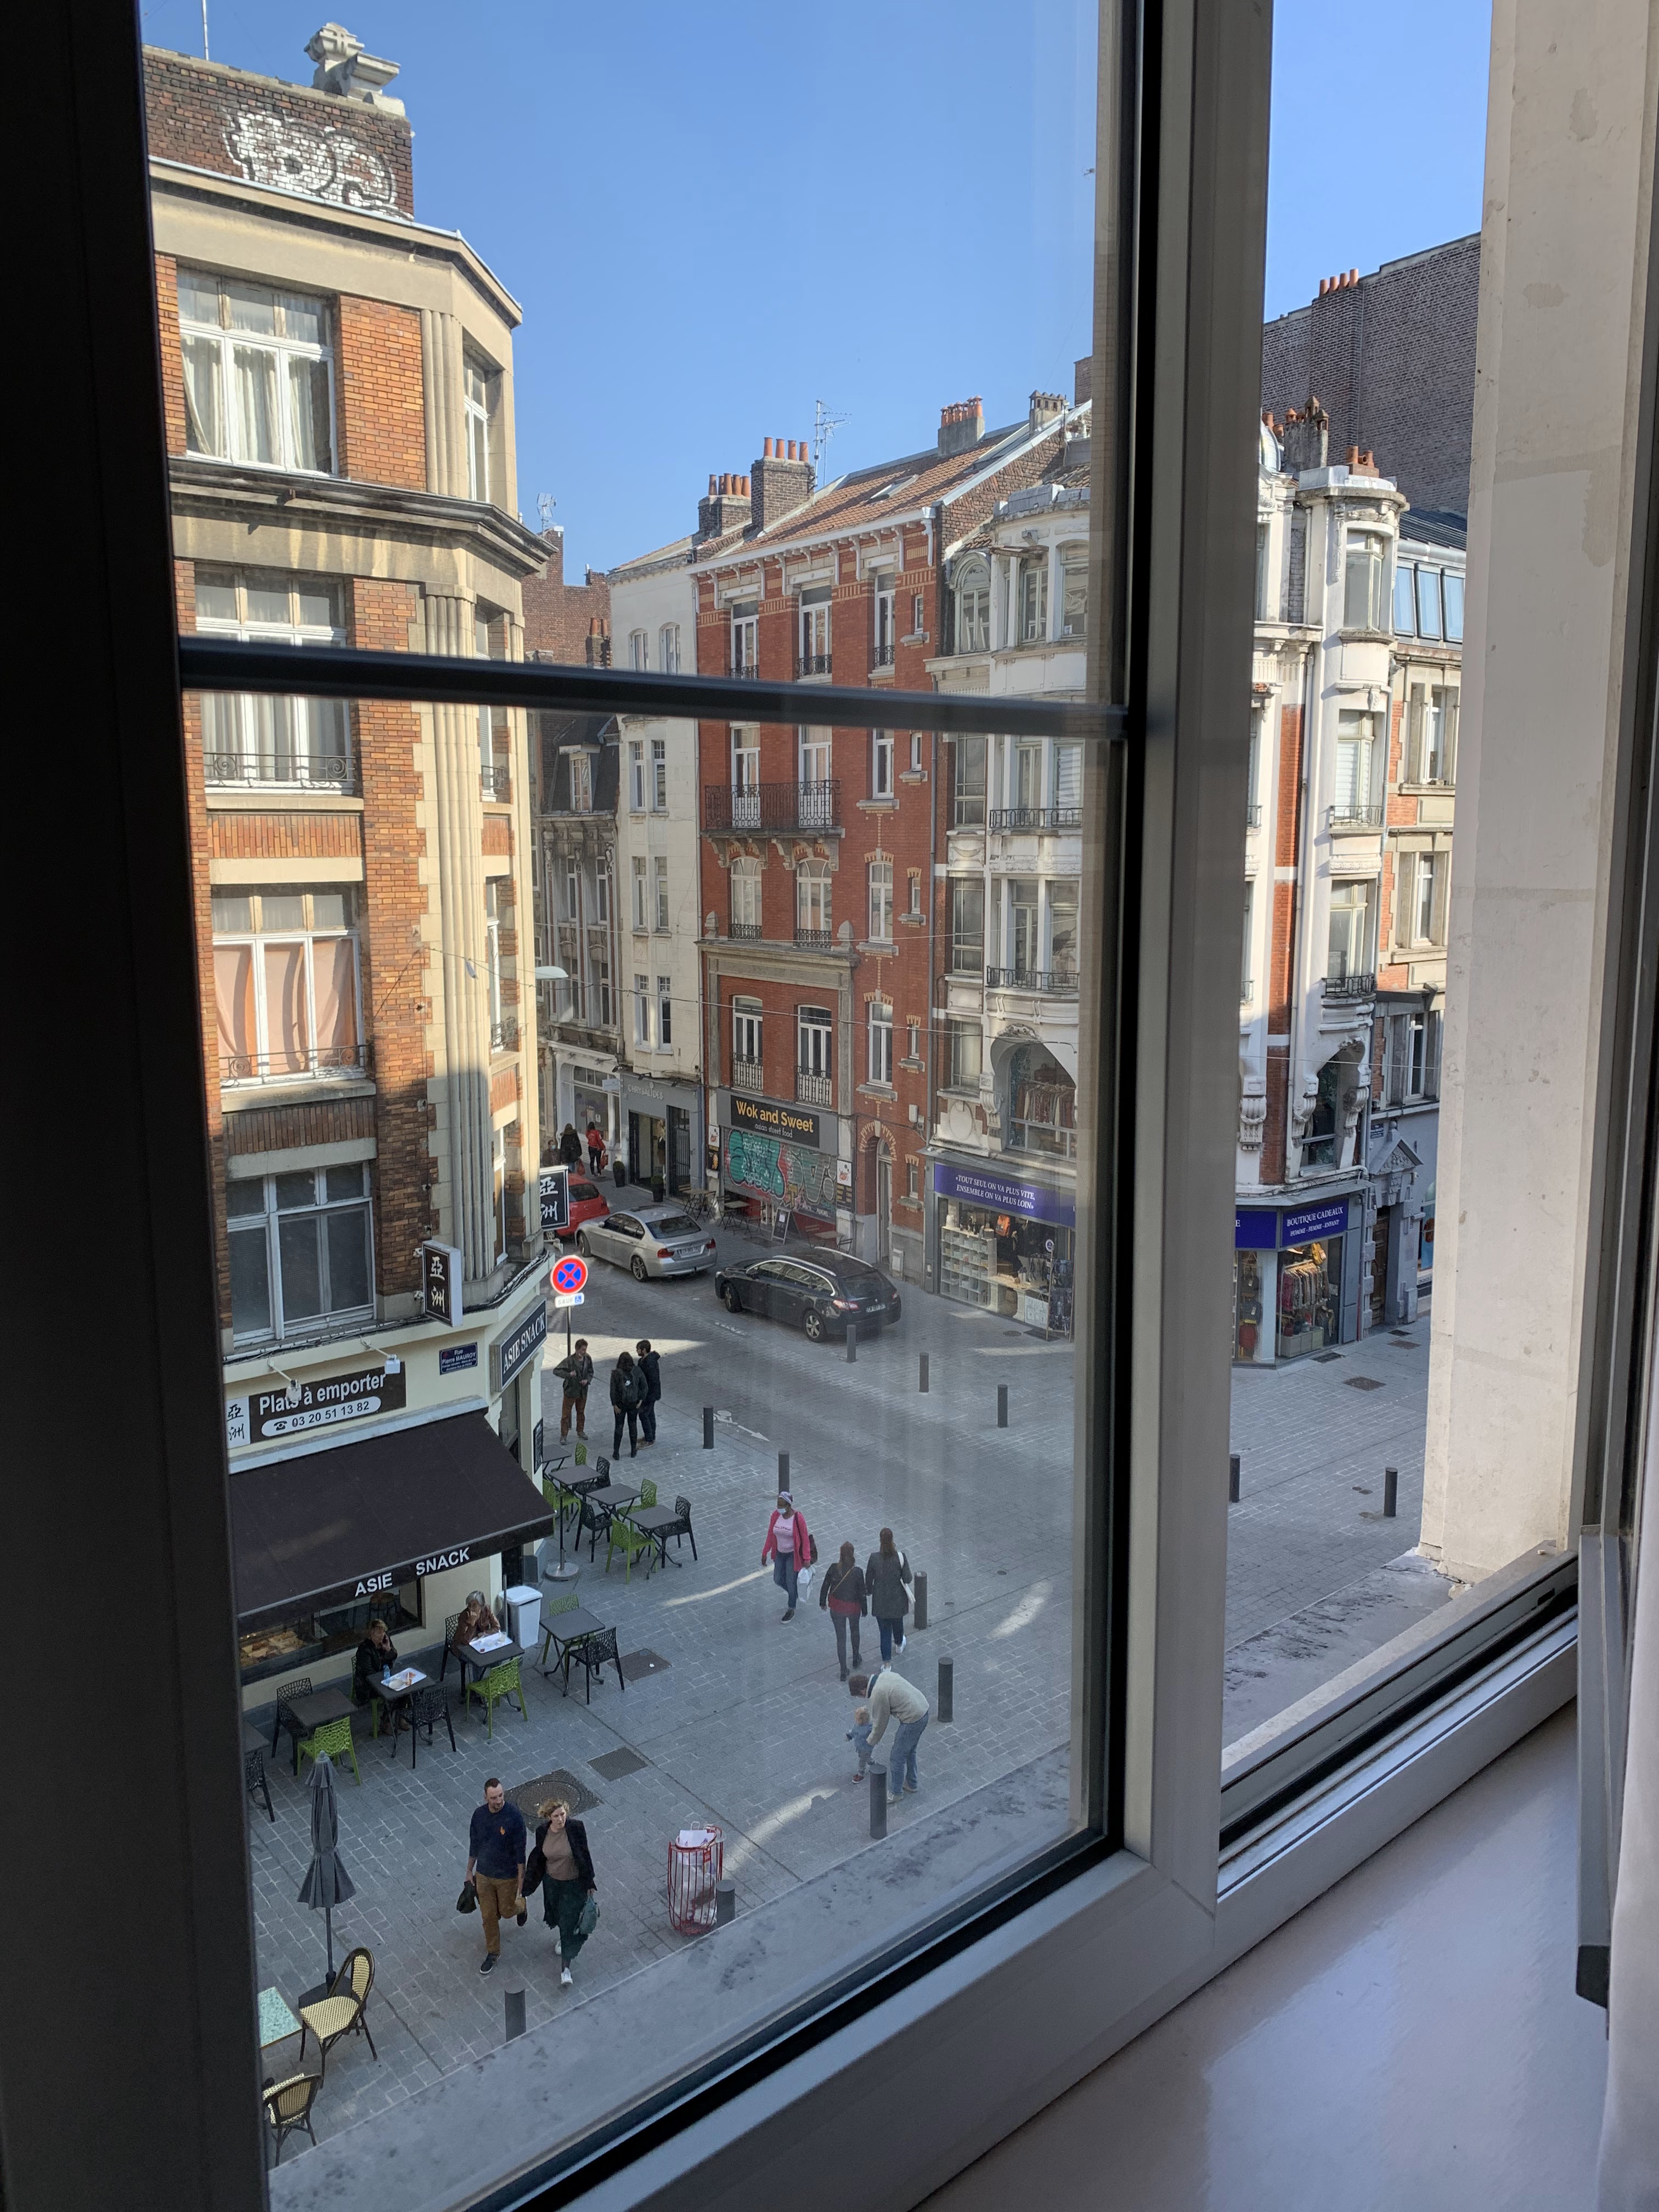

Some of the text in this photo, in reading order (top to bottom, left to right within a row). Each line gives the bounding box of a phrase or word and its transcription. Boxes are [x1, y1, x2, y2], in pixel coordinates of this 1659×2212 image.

[736, 1100, 814, 1133] Wok and Sweet
[755, 1123, 793, 1138] asian street food
[956, 1184, 984, 1198] ENSEMBLE
[985, 1191, 994, 1199] ON
[994, 1193, 1001, 1201] VA
[1002, 1195, 1017, 1205] PLUS
[974, 1179, 987, 1187] SEUL
[997, 1184, 1005, 1193] VA
[1006, 1187, 1020, 1196] PLUS
[1020, 1190, 1035, 1201] VITE,
[1286, 1206, 1344, 1227] BOUTIQUE CADEAUX
[1290, 1227, 1306, 1237] HOMME
[1308, 1223, 1323, 1232] FEMME
[1324, 1219, 1340, 1228] ENFANT
[430, 1256, 445, 1313] 亞洲
[503, 1312, 545, 1374] ASIE SNACK
[456, 1352, 476, 1361] MAUROY
[259, 1373, 386, 1415] Plats à emporter
[227, 1403, 245, 1441] 亞洲
[291, 1401, 370, 1427] 03 20 51 13 82
[354, 1547, 470, 1597] ASIE SNACK
